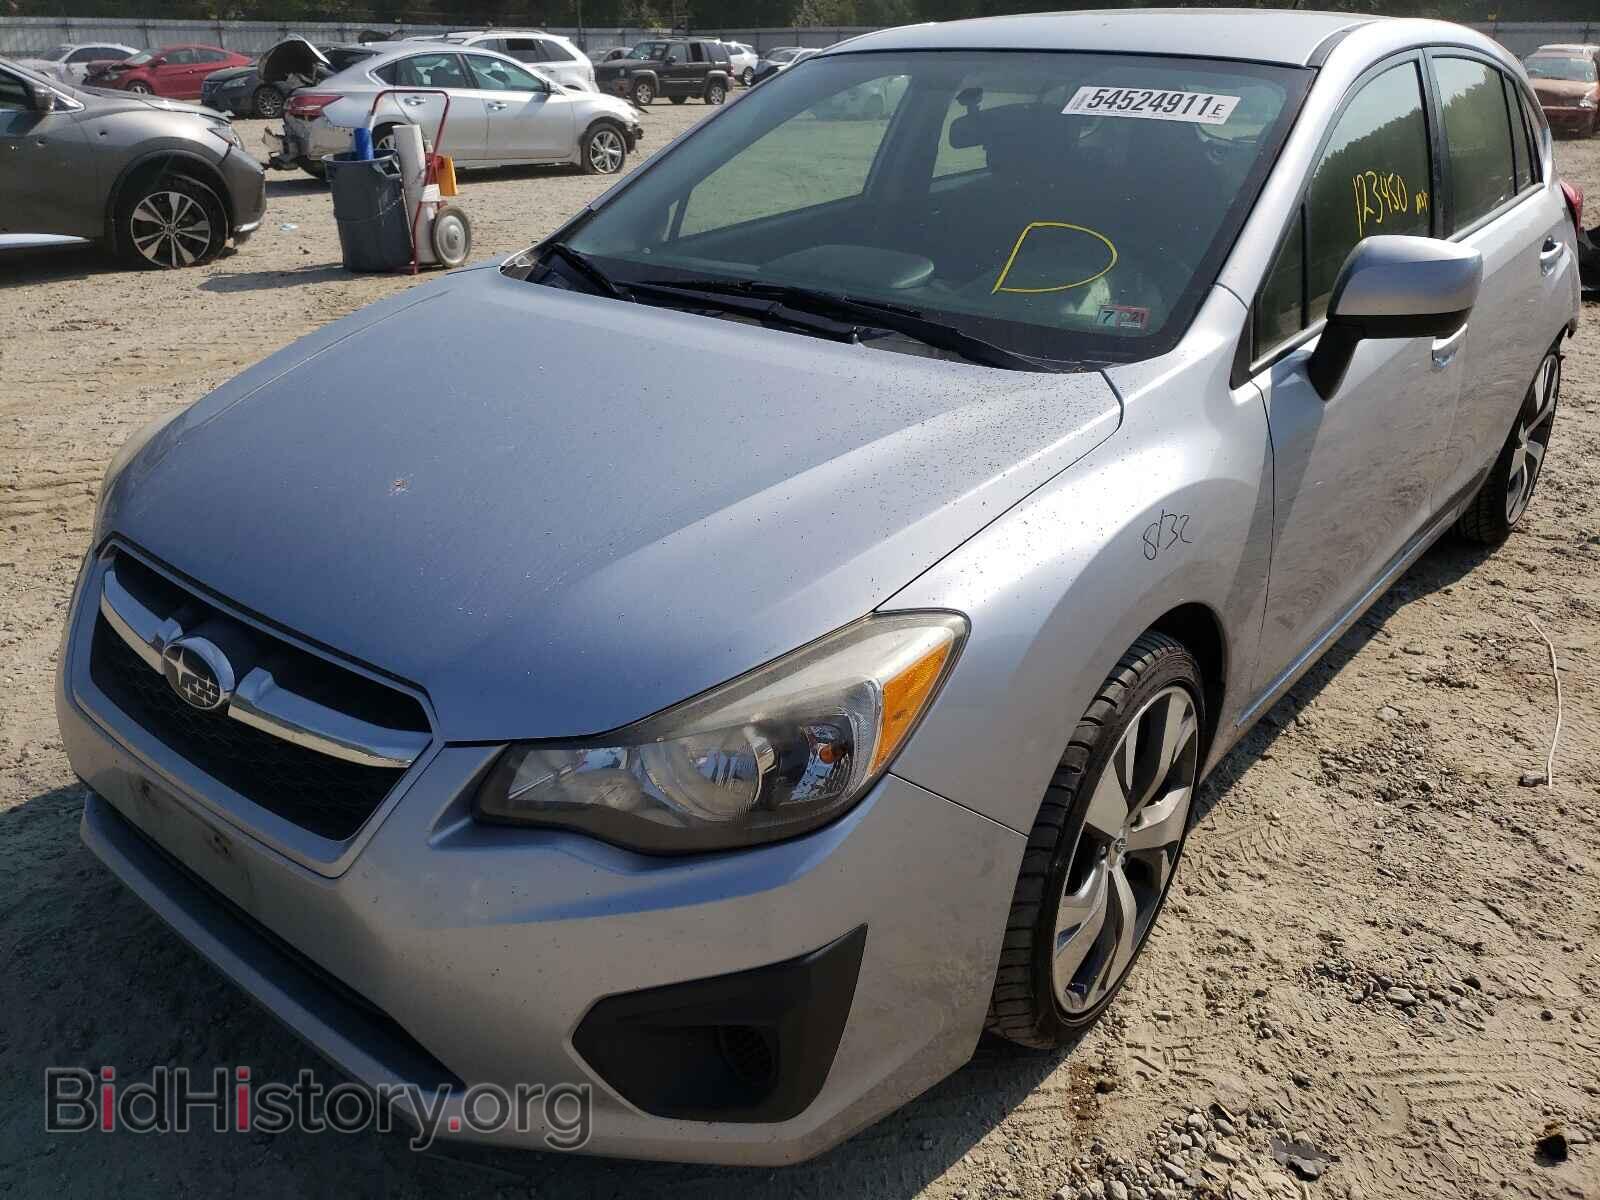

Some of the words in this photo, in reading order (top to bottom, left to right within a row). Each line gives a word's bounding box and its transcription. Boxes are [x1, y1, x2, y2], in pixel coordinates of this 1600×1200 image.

[1087, 88, 1214, 116] 54524911
[1352, 170, 1408, 237] 123450
[991, 222, 1118, 294] D
[1103, 311, 1114, 324] 7
